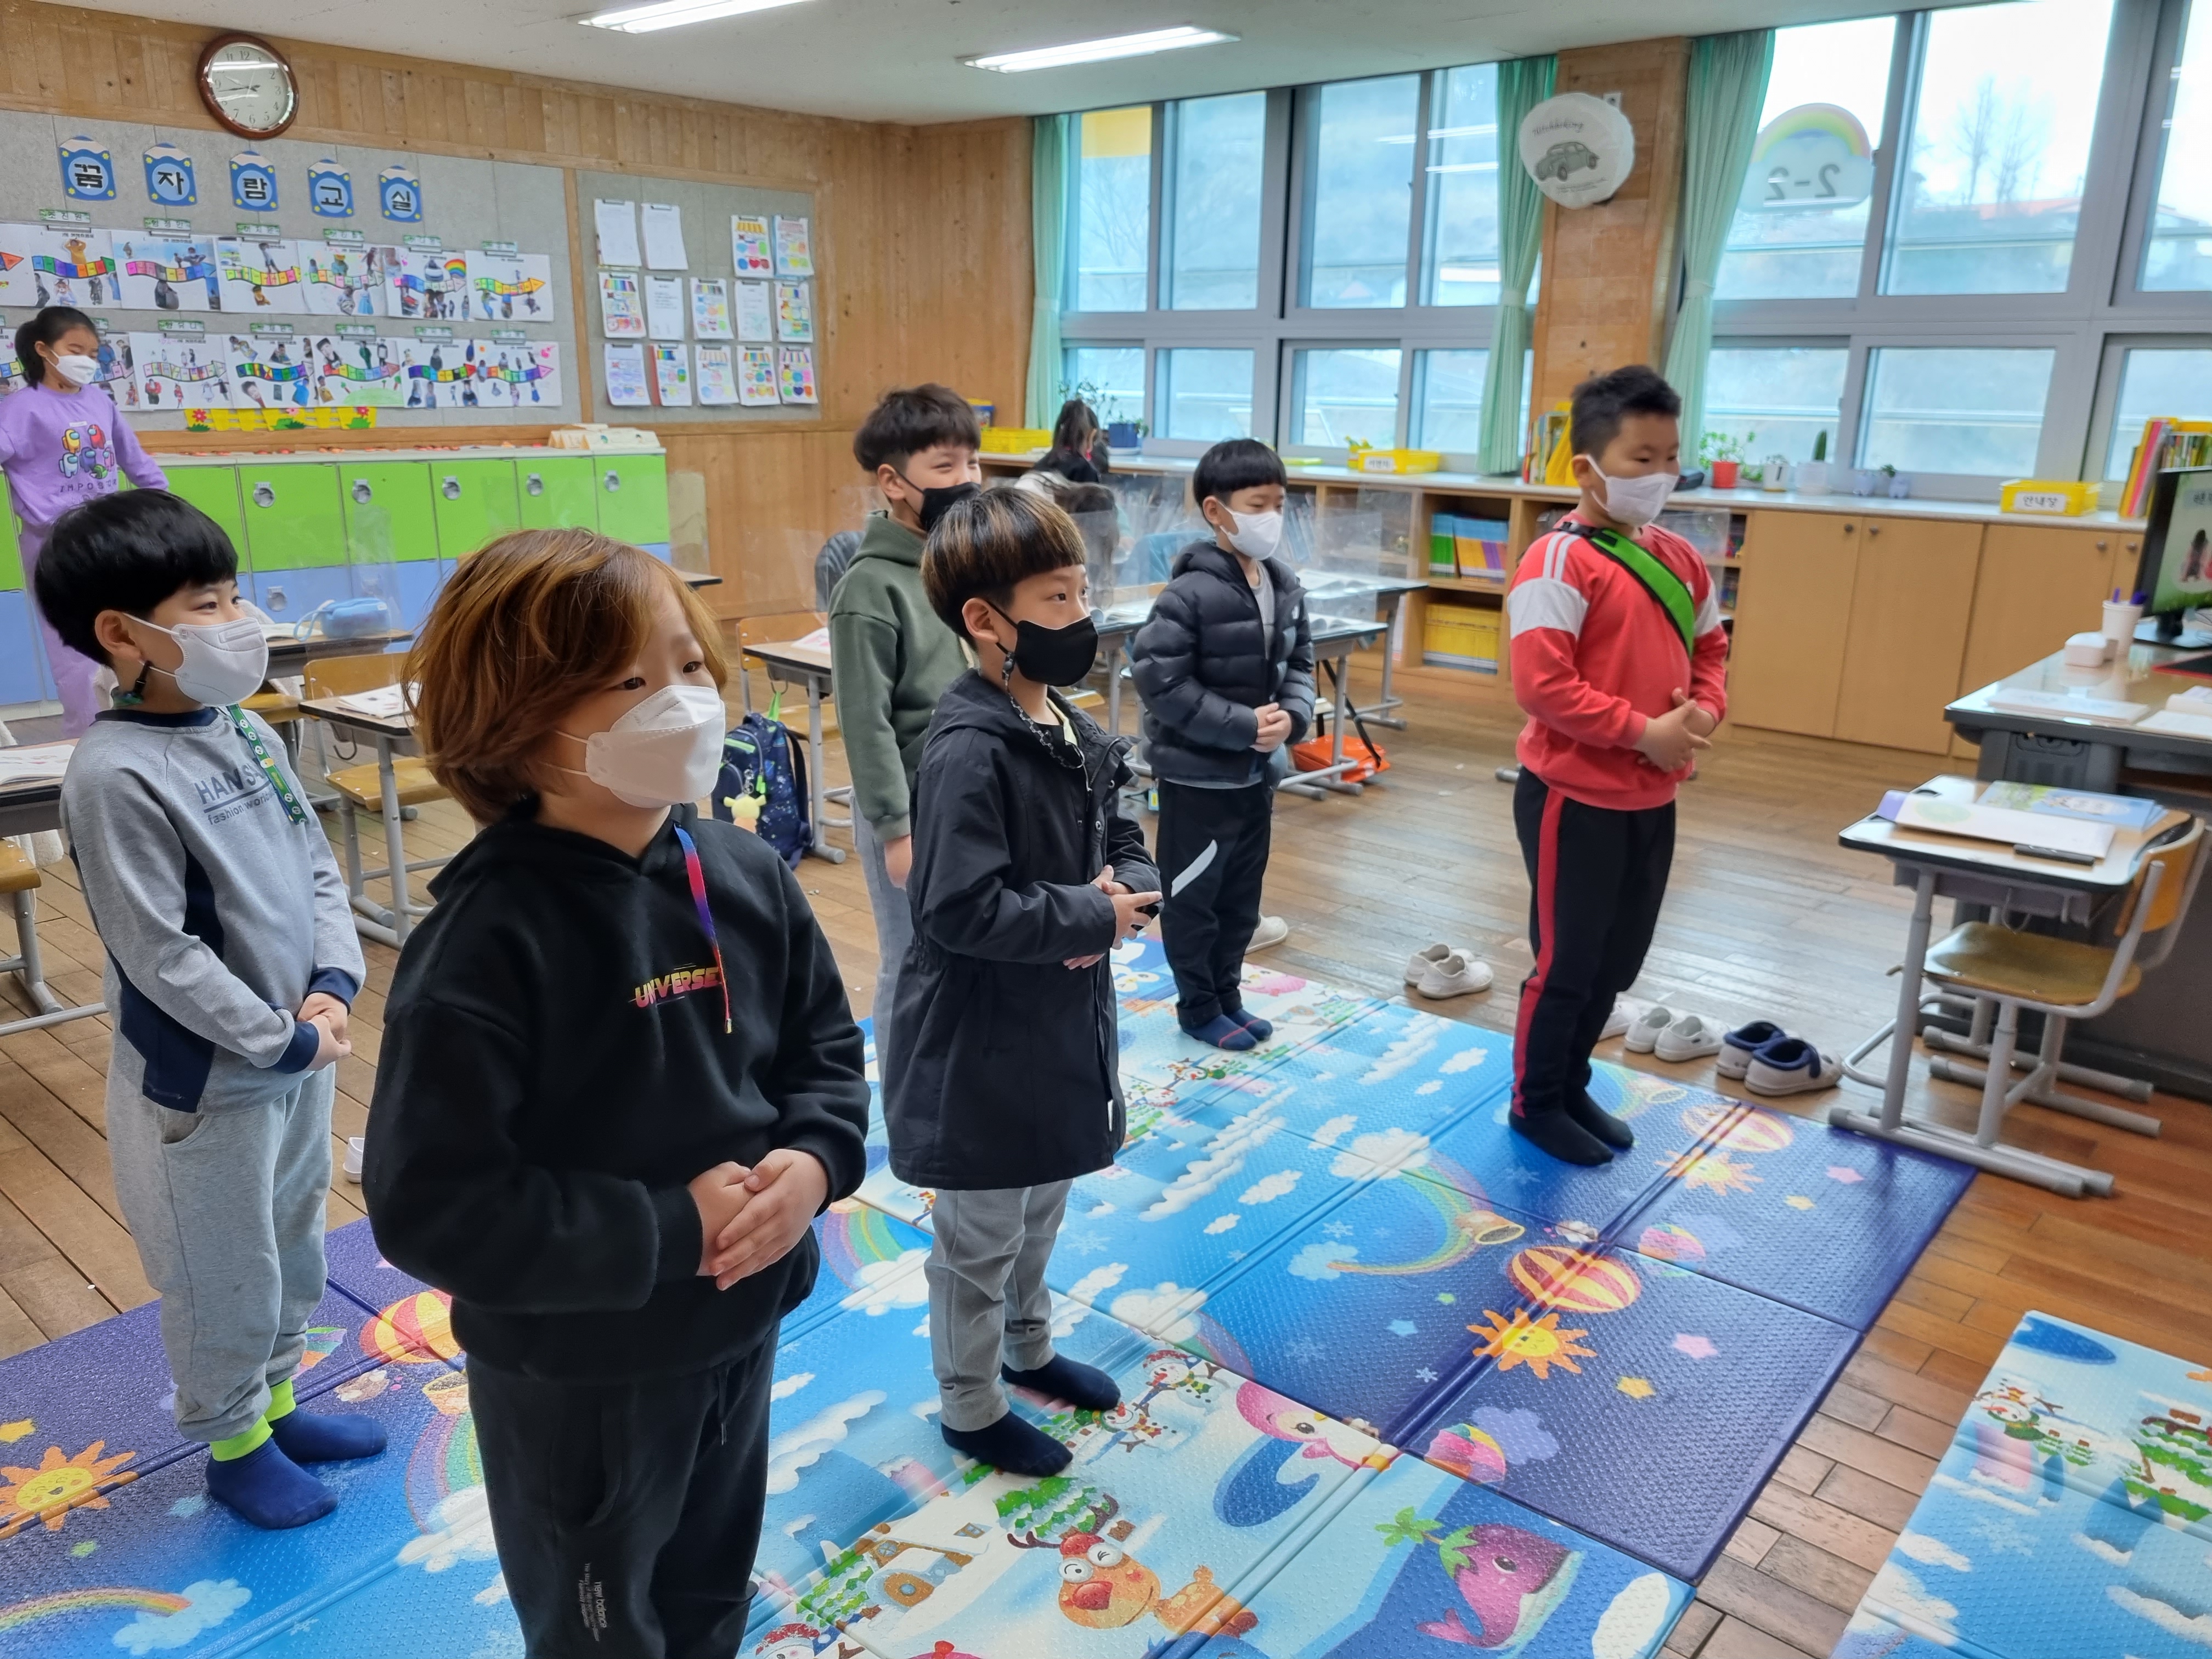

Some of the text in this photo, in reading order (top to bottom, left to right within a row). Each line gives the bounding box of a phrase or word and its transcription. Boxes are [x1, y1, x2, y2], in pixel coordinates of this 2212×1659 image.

[226, 53, 233, 61] 11
[239, 50, 250, 60] 12
[269, 71, 275, 80] 2
[275, 86, 281, 95] 3
[273, 101, 279, 111] 4
[233, 109, 239, 119] 7
[249, 114, 256, 124] 6
[263, 111, 269, 121] 5
[208, 805, 245, 825] fashion
[594, 1582, 607, 1628] new balance
